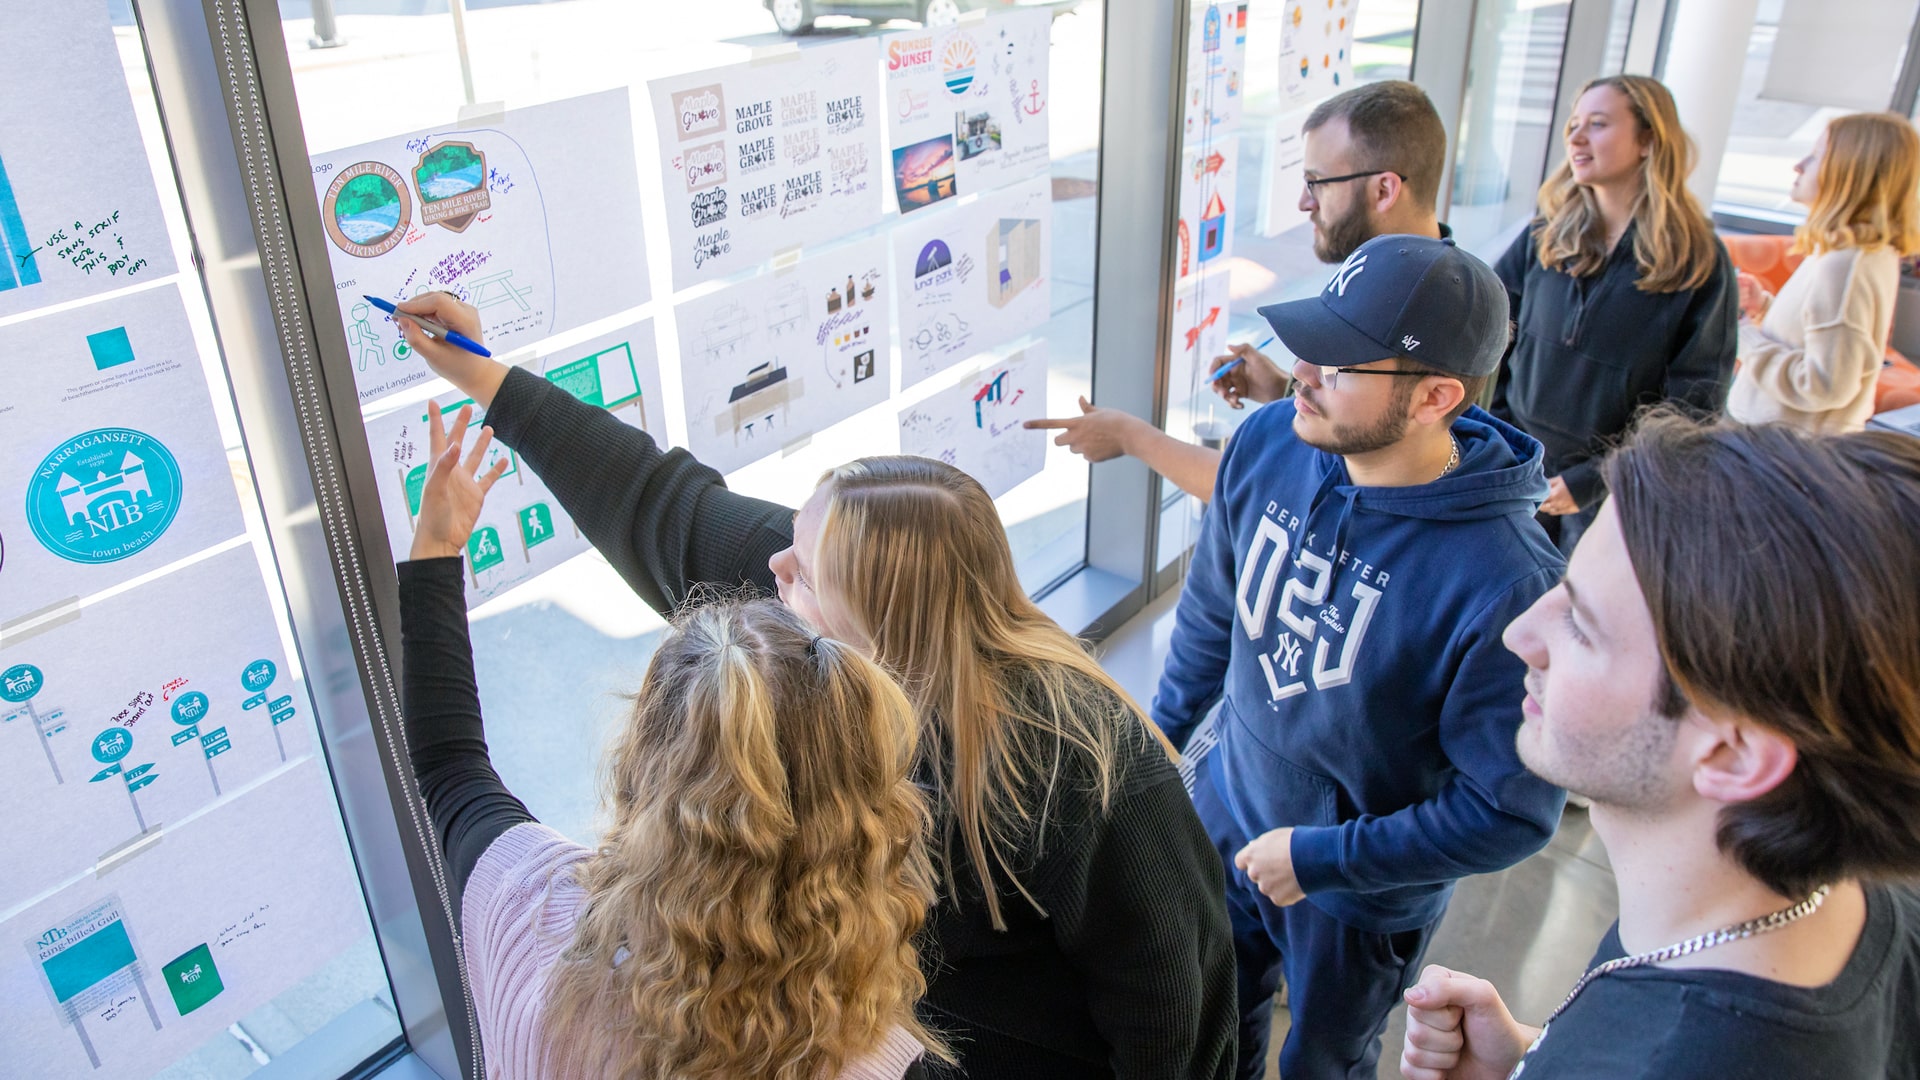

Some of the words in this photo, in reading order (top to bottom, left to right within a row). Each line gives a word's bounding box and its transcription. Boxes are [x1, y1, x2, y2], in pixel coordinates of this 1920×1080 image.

[735, 101, 772, 120] MAPLE
[780, 90, 817, 108] MAPLE
[826, 96, 862, 114] MAPLE
[736, 114, 773, 134] GROVE
[738, 136, 775, 157] MAPLE
[783, 127, 819, 147] MAPLE
[327, 178, 345, 199] TEN
[346, 162, 372, 180] MILE
[374, 163, 403, 187] RIVER
[785, 170, 822, 190] MAPLE
[422, 202, 441, 215] TEN
[441, 197, 462, 211] MILE
[463, 190, 488, 205] RIVER
[740, 184, 776, 205] MAPLE
[424, 210, 448, 223] HIKING
[470, 199, 490, 211] TRAIL
[46, 229, 68, 247] USE
[73, 220, 84, 231] A
[344, 242, 383, 257] HIKING
[383, 226, 406, 250] PATH
[693, 227, 730, 250] Maple
[57, 238, 85, 259] SANS
[71, 247, 95, 267] FOR
[81, 252, 107, 275] THIS
[127, 258, 147, 276] COPY
[336, 279, 357, 290] cons
[359, 385, 385, 400] Averie
[386, 370, 426, 389] Langdeau
[40, 432, 146, 480] NARRAGANSETT
[77, 450, 114, 468] Established
[85, 499, 144, 539] NTB
[1266, 499, 1318, 548] DERK
[92, 547, 121, 558] town
[121, 530, 154, 552] beach
[1319, 609, 1345, 634] Captain
[1328, 604, 1340, 620] The
[37, 927, 67, 950] NTB
[40, 923, 97, 960] Ring-billed
[97, 910, 120, 928] Gull
